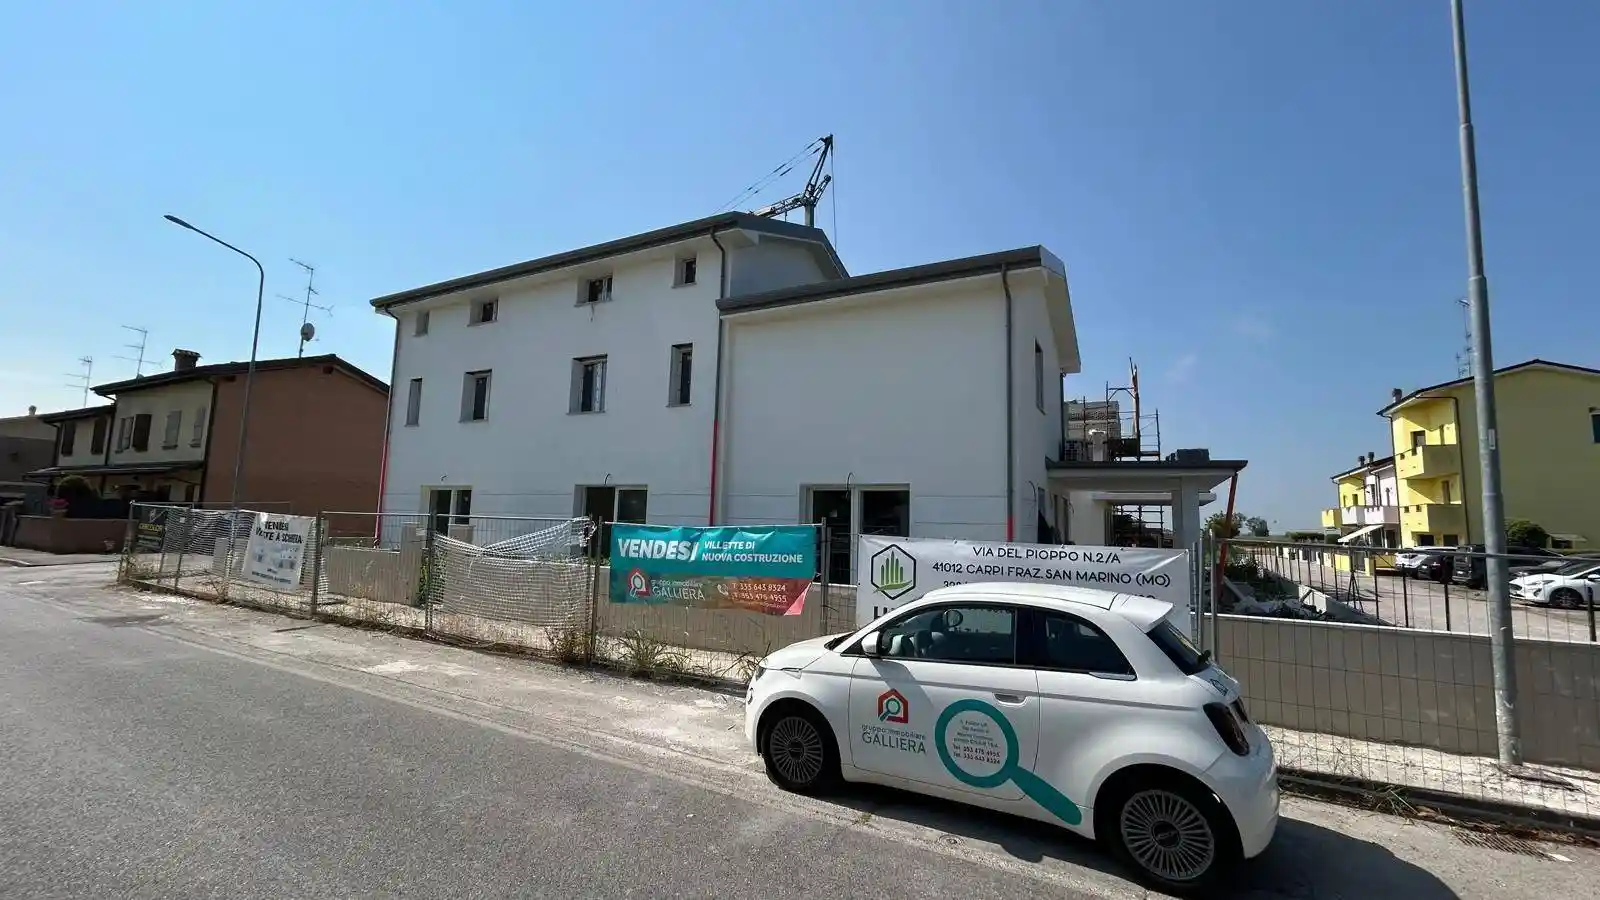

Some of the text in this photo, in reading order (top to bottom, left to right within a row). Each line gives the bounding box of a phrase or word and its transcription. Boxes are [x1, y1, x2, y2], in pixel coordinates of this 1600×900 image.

[704, 540, 755, 550] VILLETTE DI
[702, 552, 804, 564] NUOVA COSTRUZIONE
[972, 546, 1121, 564] VIA DEL PIOPPO N.2/A
[933, 562, 1171, 588] 41012 CARPI FRAZ. SAN MARINO (MO)
[652, 586, 706, 601] GALLIERA
[753, 583, 767, 591] 643
[861, 731, 927, 754] GALLIERA
